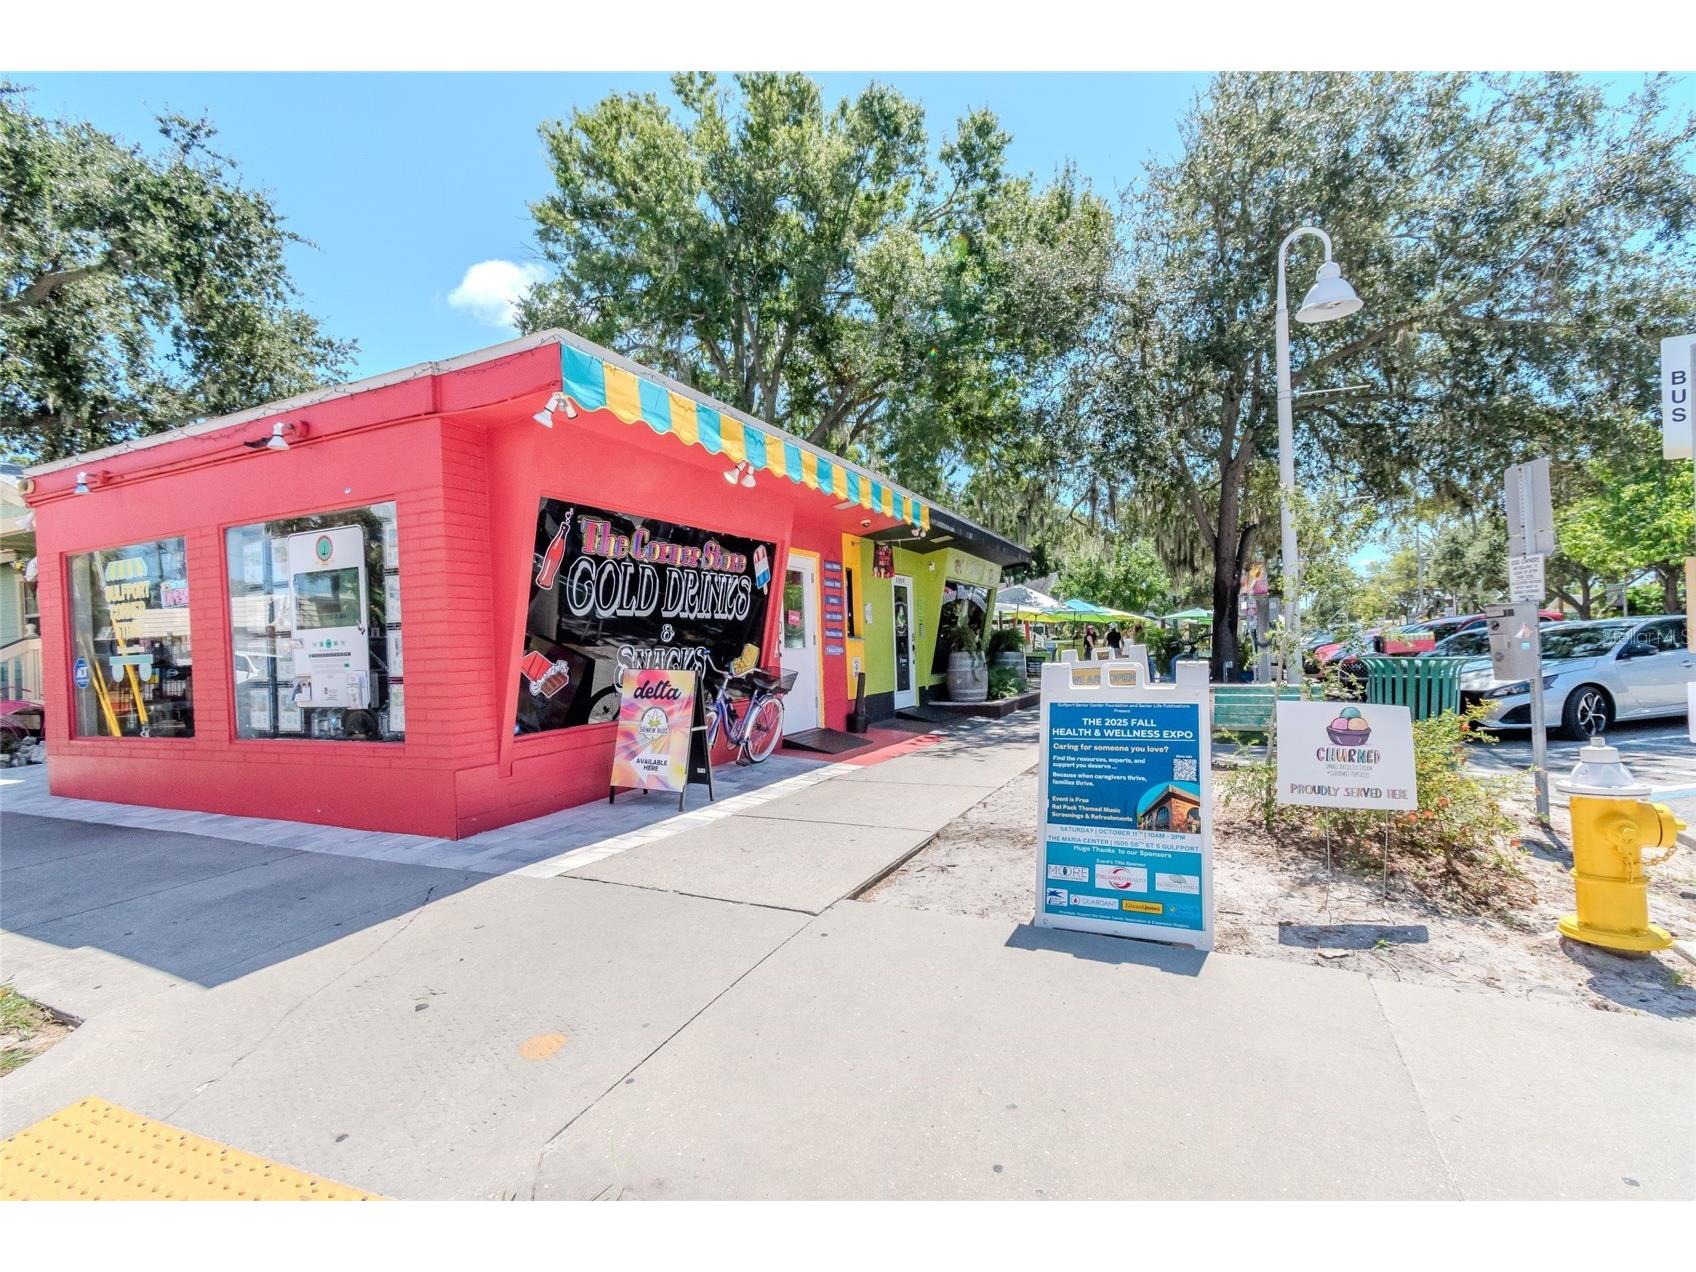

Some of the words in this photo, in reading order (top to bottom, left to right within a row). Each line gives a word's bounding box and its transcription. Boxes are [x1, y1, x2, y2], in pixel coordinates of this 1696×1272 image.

[1671, 370, 1687, 422] BUS
[578, 516, 630, 559] The
[629, 528, 701, 568] Corner
[701, 540, 747, 573] Store
[566, 555, 659, 617] COLD
[661, 567, 752, 621] DRINKS
[660, 623, 675, 643] &
[633, 680, 682, 701] delta
[1082, 717, 1102, 726] THE
[1104, 718, 1129, 726] 2025
[1131, 718, 1157, 727] FALL
[1052, 727, 1092, 736] HEALTH
[1094, 728, 1101, 737] &
[1103, 729, 1160, 738] WELLNESS
[1163, 730, 1193, 739] EXPO
[1053, 742, 1079, 752] Caring
[1080, 743, 1092, 751] for
[1131, 746, 1146, 754] you
[1316, 746, 1381, 764] CHURNED
[636, 758, 668, 766] AVAILABLE
[1289, 783, 1341, 797] PROUDLY
[1344, 787, 1382, 799] SERVED
[1387, 789, 1409, 800] HERE
[1079, 805, 1102, 813] Themed
[1051, 811, 1084, 820] Screenings
[1091, 813, 1134, 822] Refreshments
[1060, 826, 1093, 834] SATURDAY
[1073, 845, 1091, 853] Huge
[1092, 846, 1116, 854] Thanks
[1140, 850, 1173, 859] Sponsors
[1161, 844, 1199, 852] GULFPORT
[1048, 865, 1088, 879] MORE
